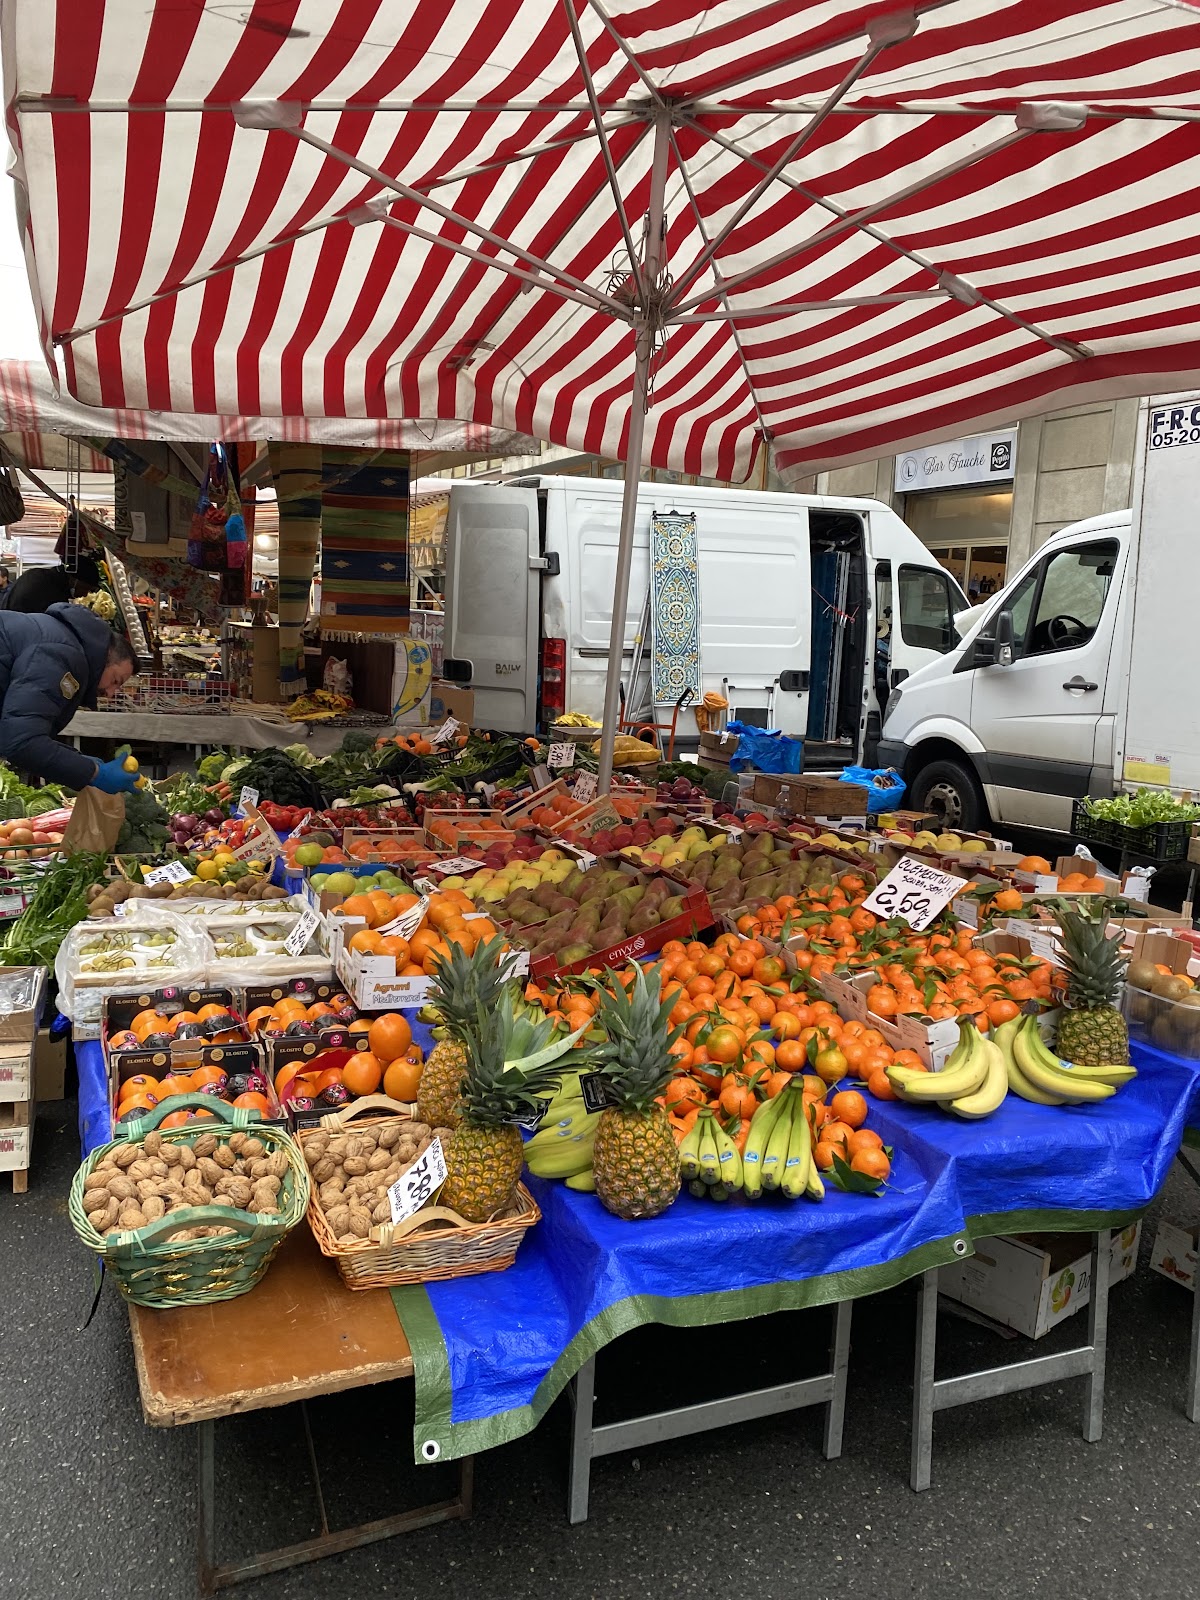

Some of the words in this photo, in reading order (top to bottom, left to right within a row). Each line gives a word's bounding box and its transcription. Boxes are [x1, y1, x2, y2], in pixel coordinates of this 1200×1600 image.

[923, 455, 945, 475] Bar
[948, 451, 986, 473] Fauché
[992, 453, 1010, 466] Pepito
[495, 663, 521, 672] DAILY
[875, 884, 931, 914] 2,50
[608, 943, 635, 961] envy
[373, 981, 411, 994] Agrumi
[407, 1156, 432, 1202] 7,80
